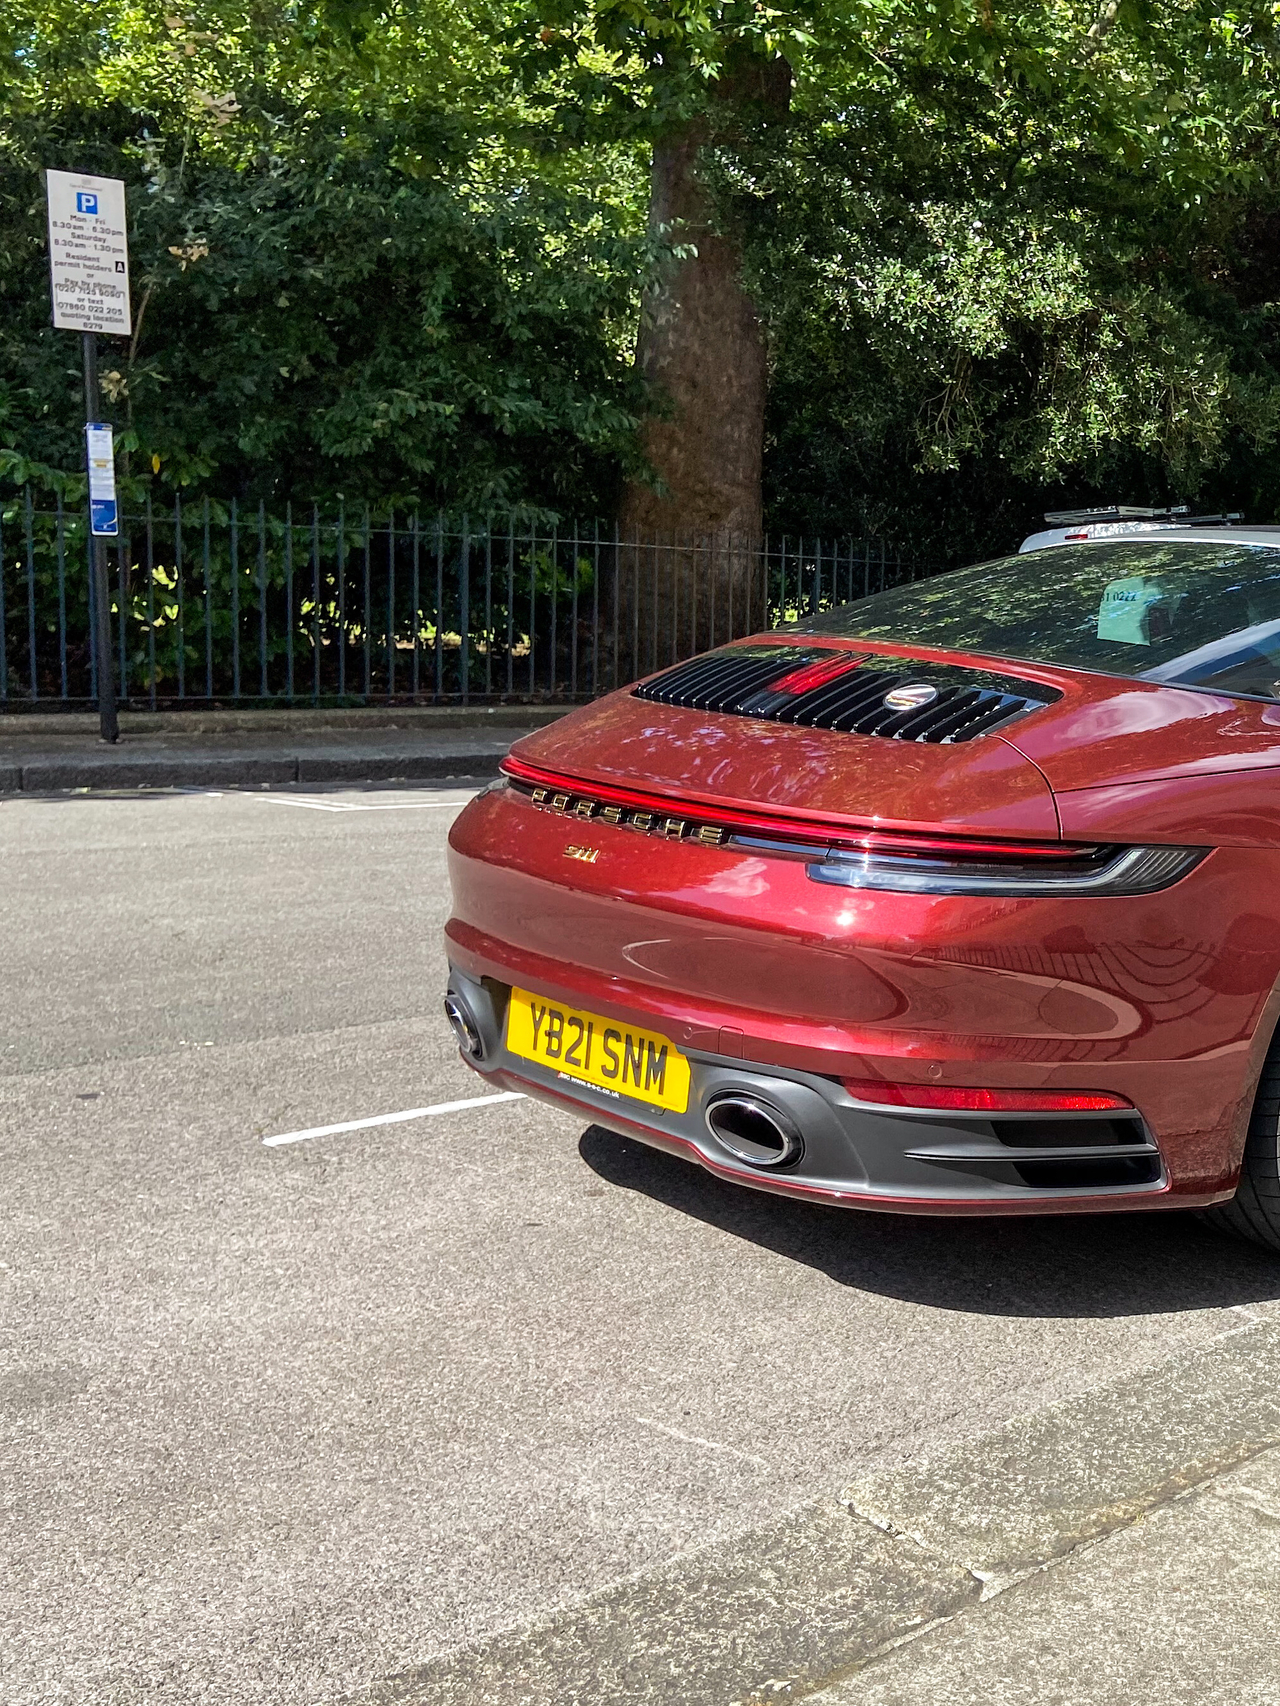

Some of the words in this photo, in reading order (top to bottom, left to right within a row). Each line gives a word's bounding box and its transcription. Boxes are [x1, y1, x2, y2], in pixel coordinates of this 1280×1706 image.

[81, 195, 95, 211] P
[71, 232, 107, 243] Saturday
[65, 252, 100, 262] Resident
[54, 261, 81, 269] permit
[83, 263, 112, 272] holders
[116, 262, 124, 273] A
[58, 284, 75, 293] 020
[64, 278, 79, 287] Pay
[81, 280, 90, 288] by
[93, 281, 116, 290] phone
[88, 305, 104, 313] 022
[106, 307, 123, 316] 205
[60, 312, 91, 321] quoting
[93, 314, 125, 324] location
[531, 788, 725, 845] PORSCHE
[562, 844, 600, 864] 911
[531, 1002, 594, 1071] YB21
[601, 1028, 669, 1096] SNM
